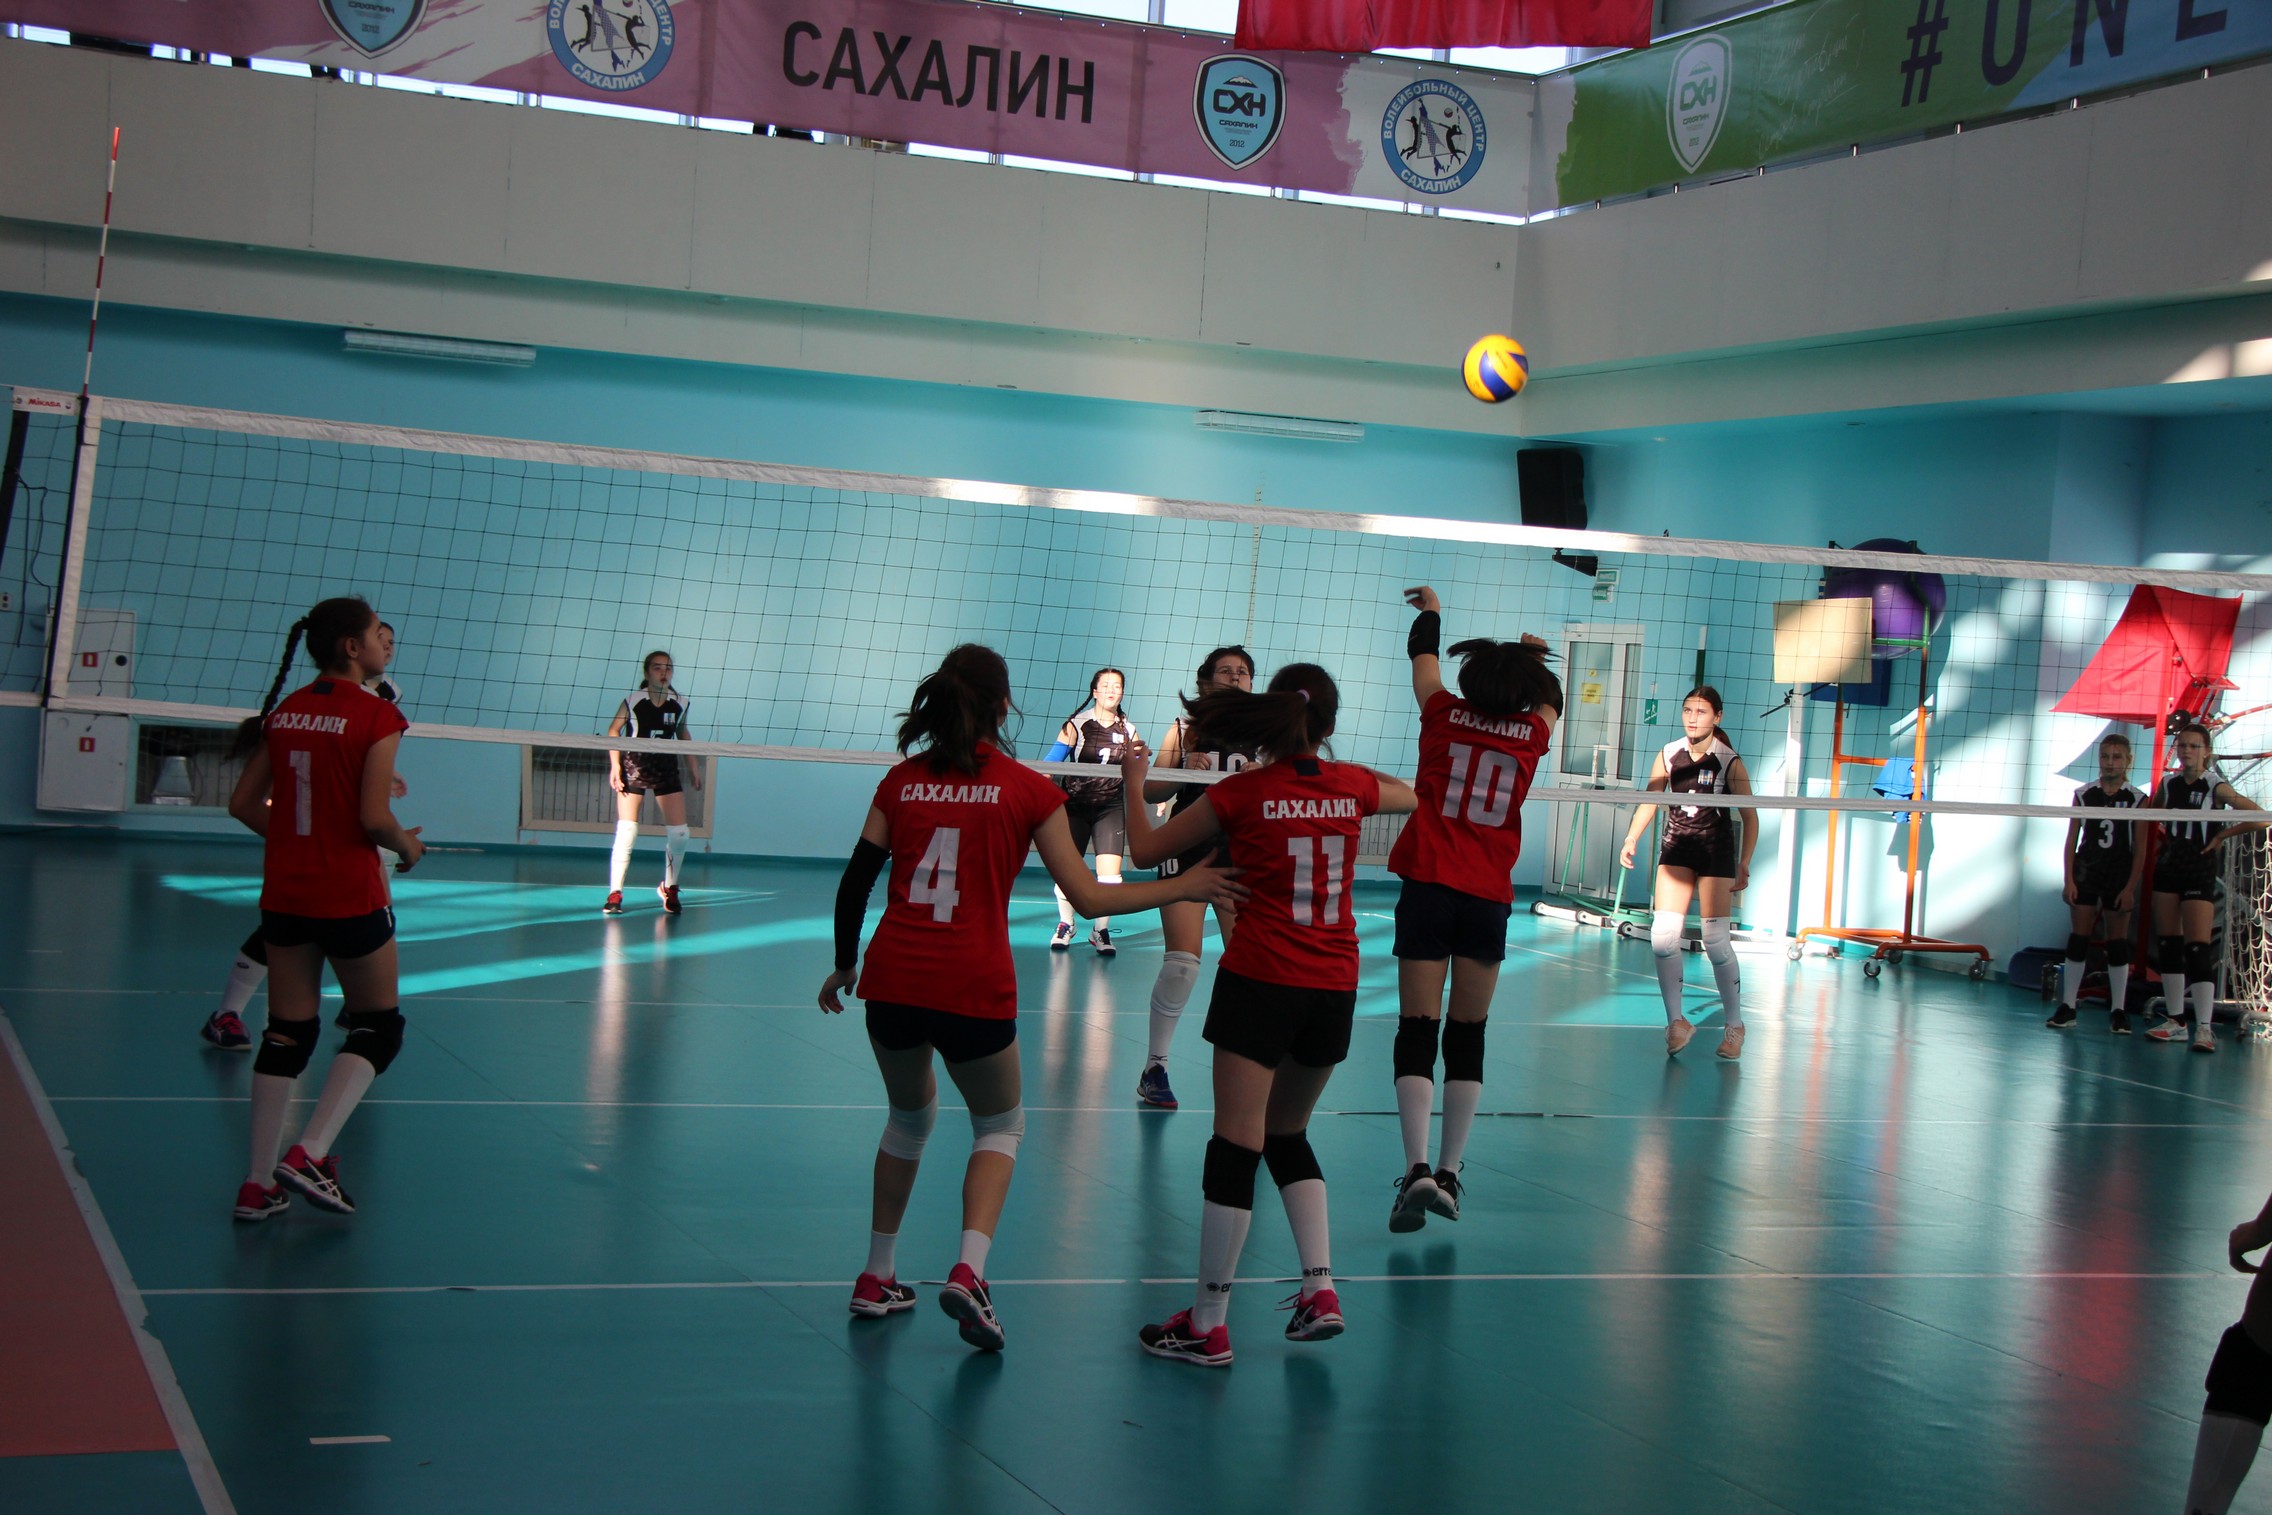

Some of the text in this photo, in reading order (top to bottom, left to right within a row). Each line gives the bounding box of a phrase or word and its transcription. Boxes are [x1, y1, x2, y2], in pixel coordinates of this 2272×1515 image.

[571, 62, 646, 89] САХАЛИН
[782, 21, 1095, 124] САХАЛИН
[1219, 119, 1258, 129] САХАЛИН
[1383, 82, 1485, 152] ВОЛЕЙБОЛЬНЫЙ ЦЕНТР
[1229, 139, 1245, 148] 2012
[1400, 169, 1462, 193] САХАЛИН
[271, 712, 348, 735] САХАЛИН
[1449, 708, 1533, 741] САХАЛИН
[289, 750, 312, 836] 1
[900, 783, 1001, 804] САХАЛИН
[1442, 742, 1519, 828] 10
[1262, 798, 1356, 820] САХАЛИН
[2097, 819, 2115, 849] 3
[908, 826, 960, 923] 4
[1159, 858, 1179, 877] 10
[1287, 835, 1345, 926] 11
